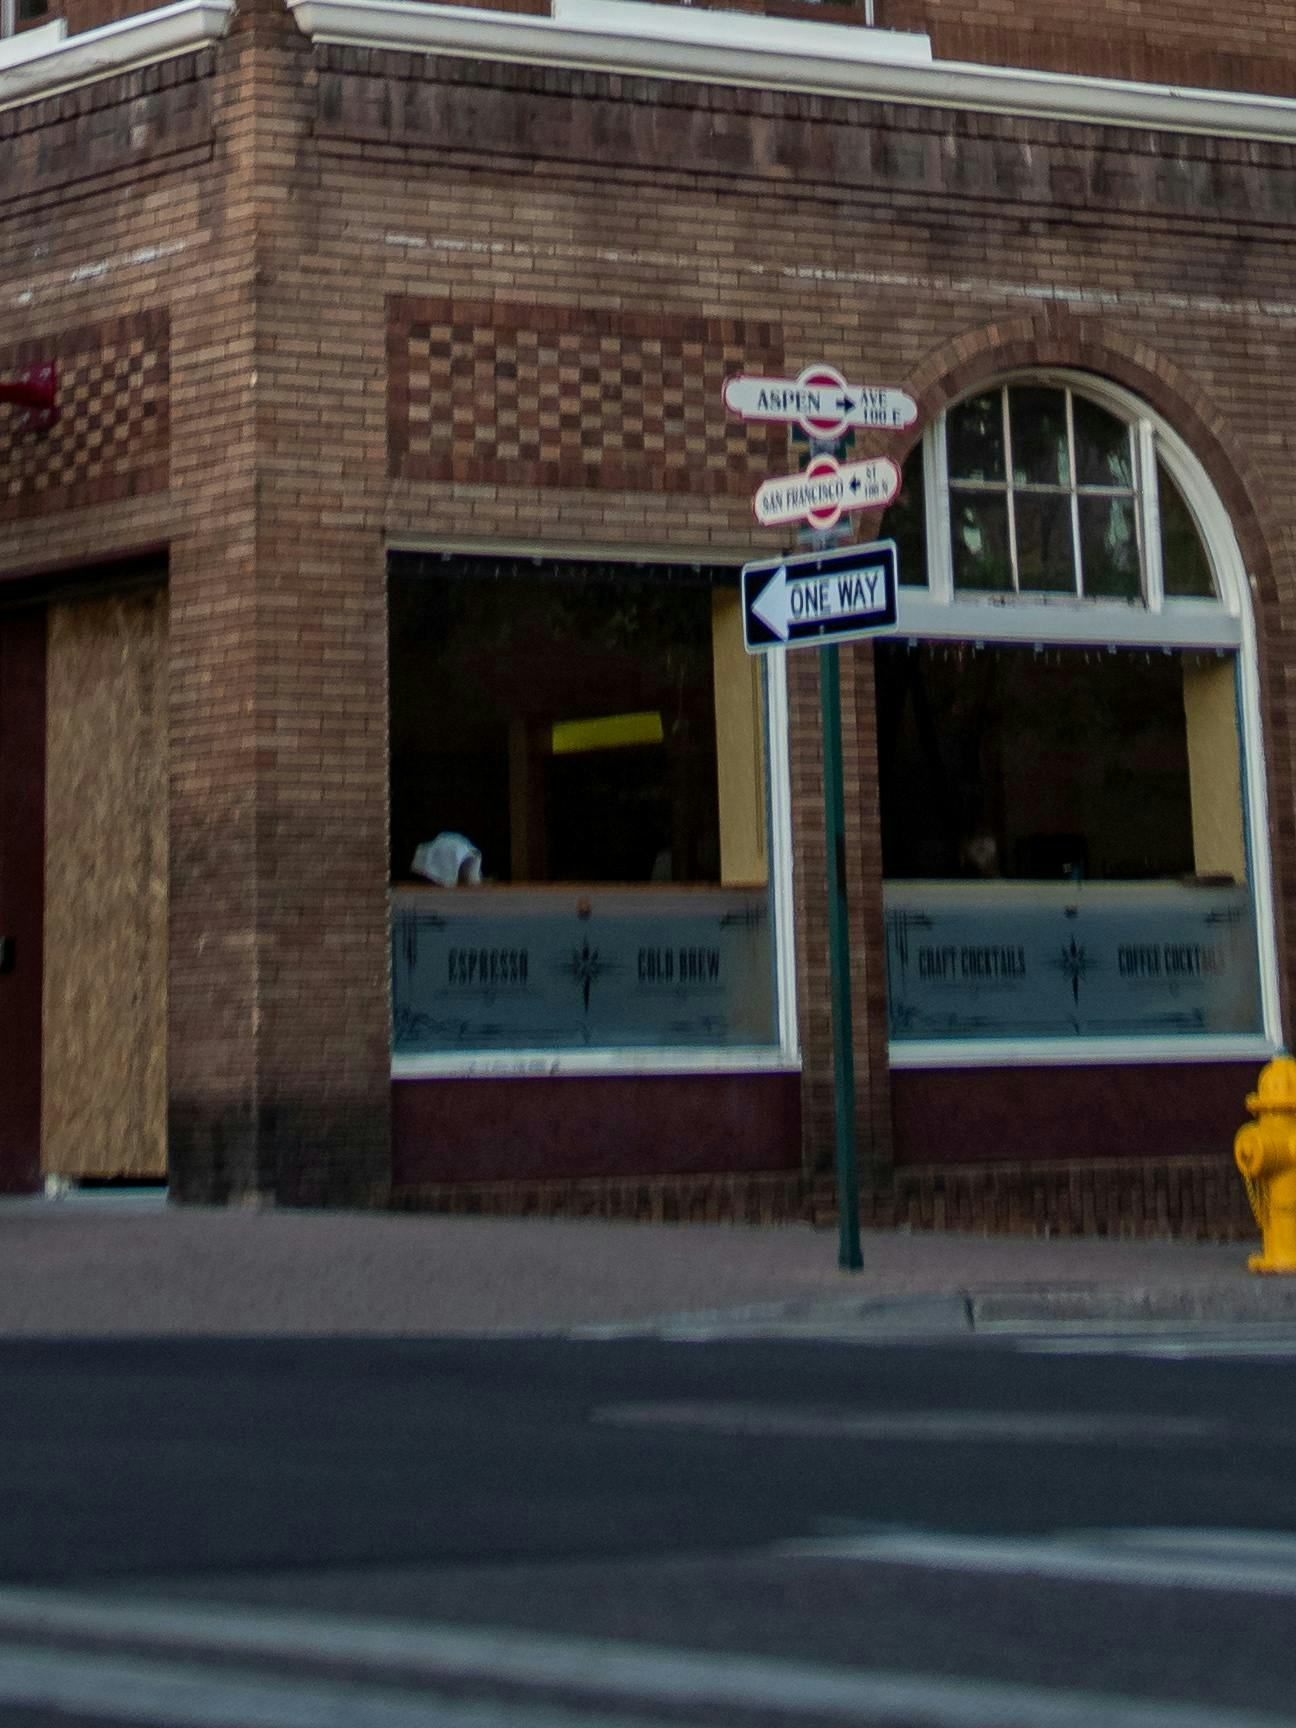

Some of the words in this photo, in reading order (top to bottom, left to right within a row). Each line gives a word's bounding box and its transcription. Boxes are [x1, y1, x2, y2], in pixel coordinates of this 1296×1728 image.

[758, 388, 821, 414] ASPEN
[860, 388, 887, 408] AVE
[863, 408, 887, 425] 100
[761, 489, 784, 515] SAN
[785, 478, 845, 511] FRANCISCO
[790, 579, 832, 621] ONE
[837, 570, 879, 613] WAY
[448, 946, 529, 985] ESPRESSO
[637, 946, 675, 985] COLD
[678, 946, 720, 985] BREW
[918, 945, 956, 982] CRAFT
[960, 944, 1027, 981] COCKTAILS
[1117, 943, 1162, 979] COFFEE
